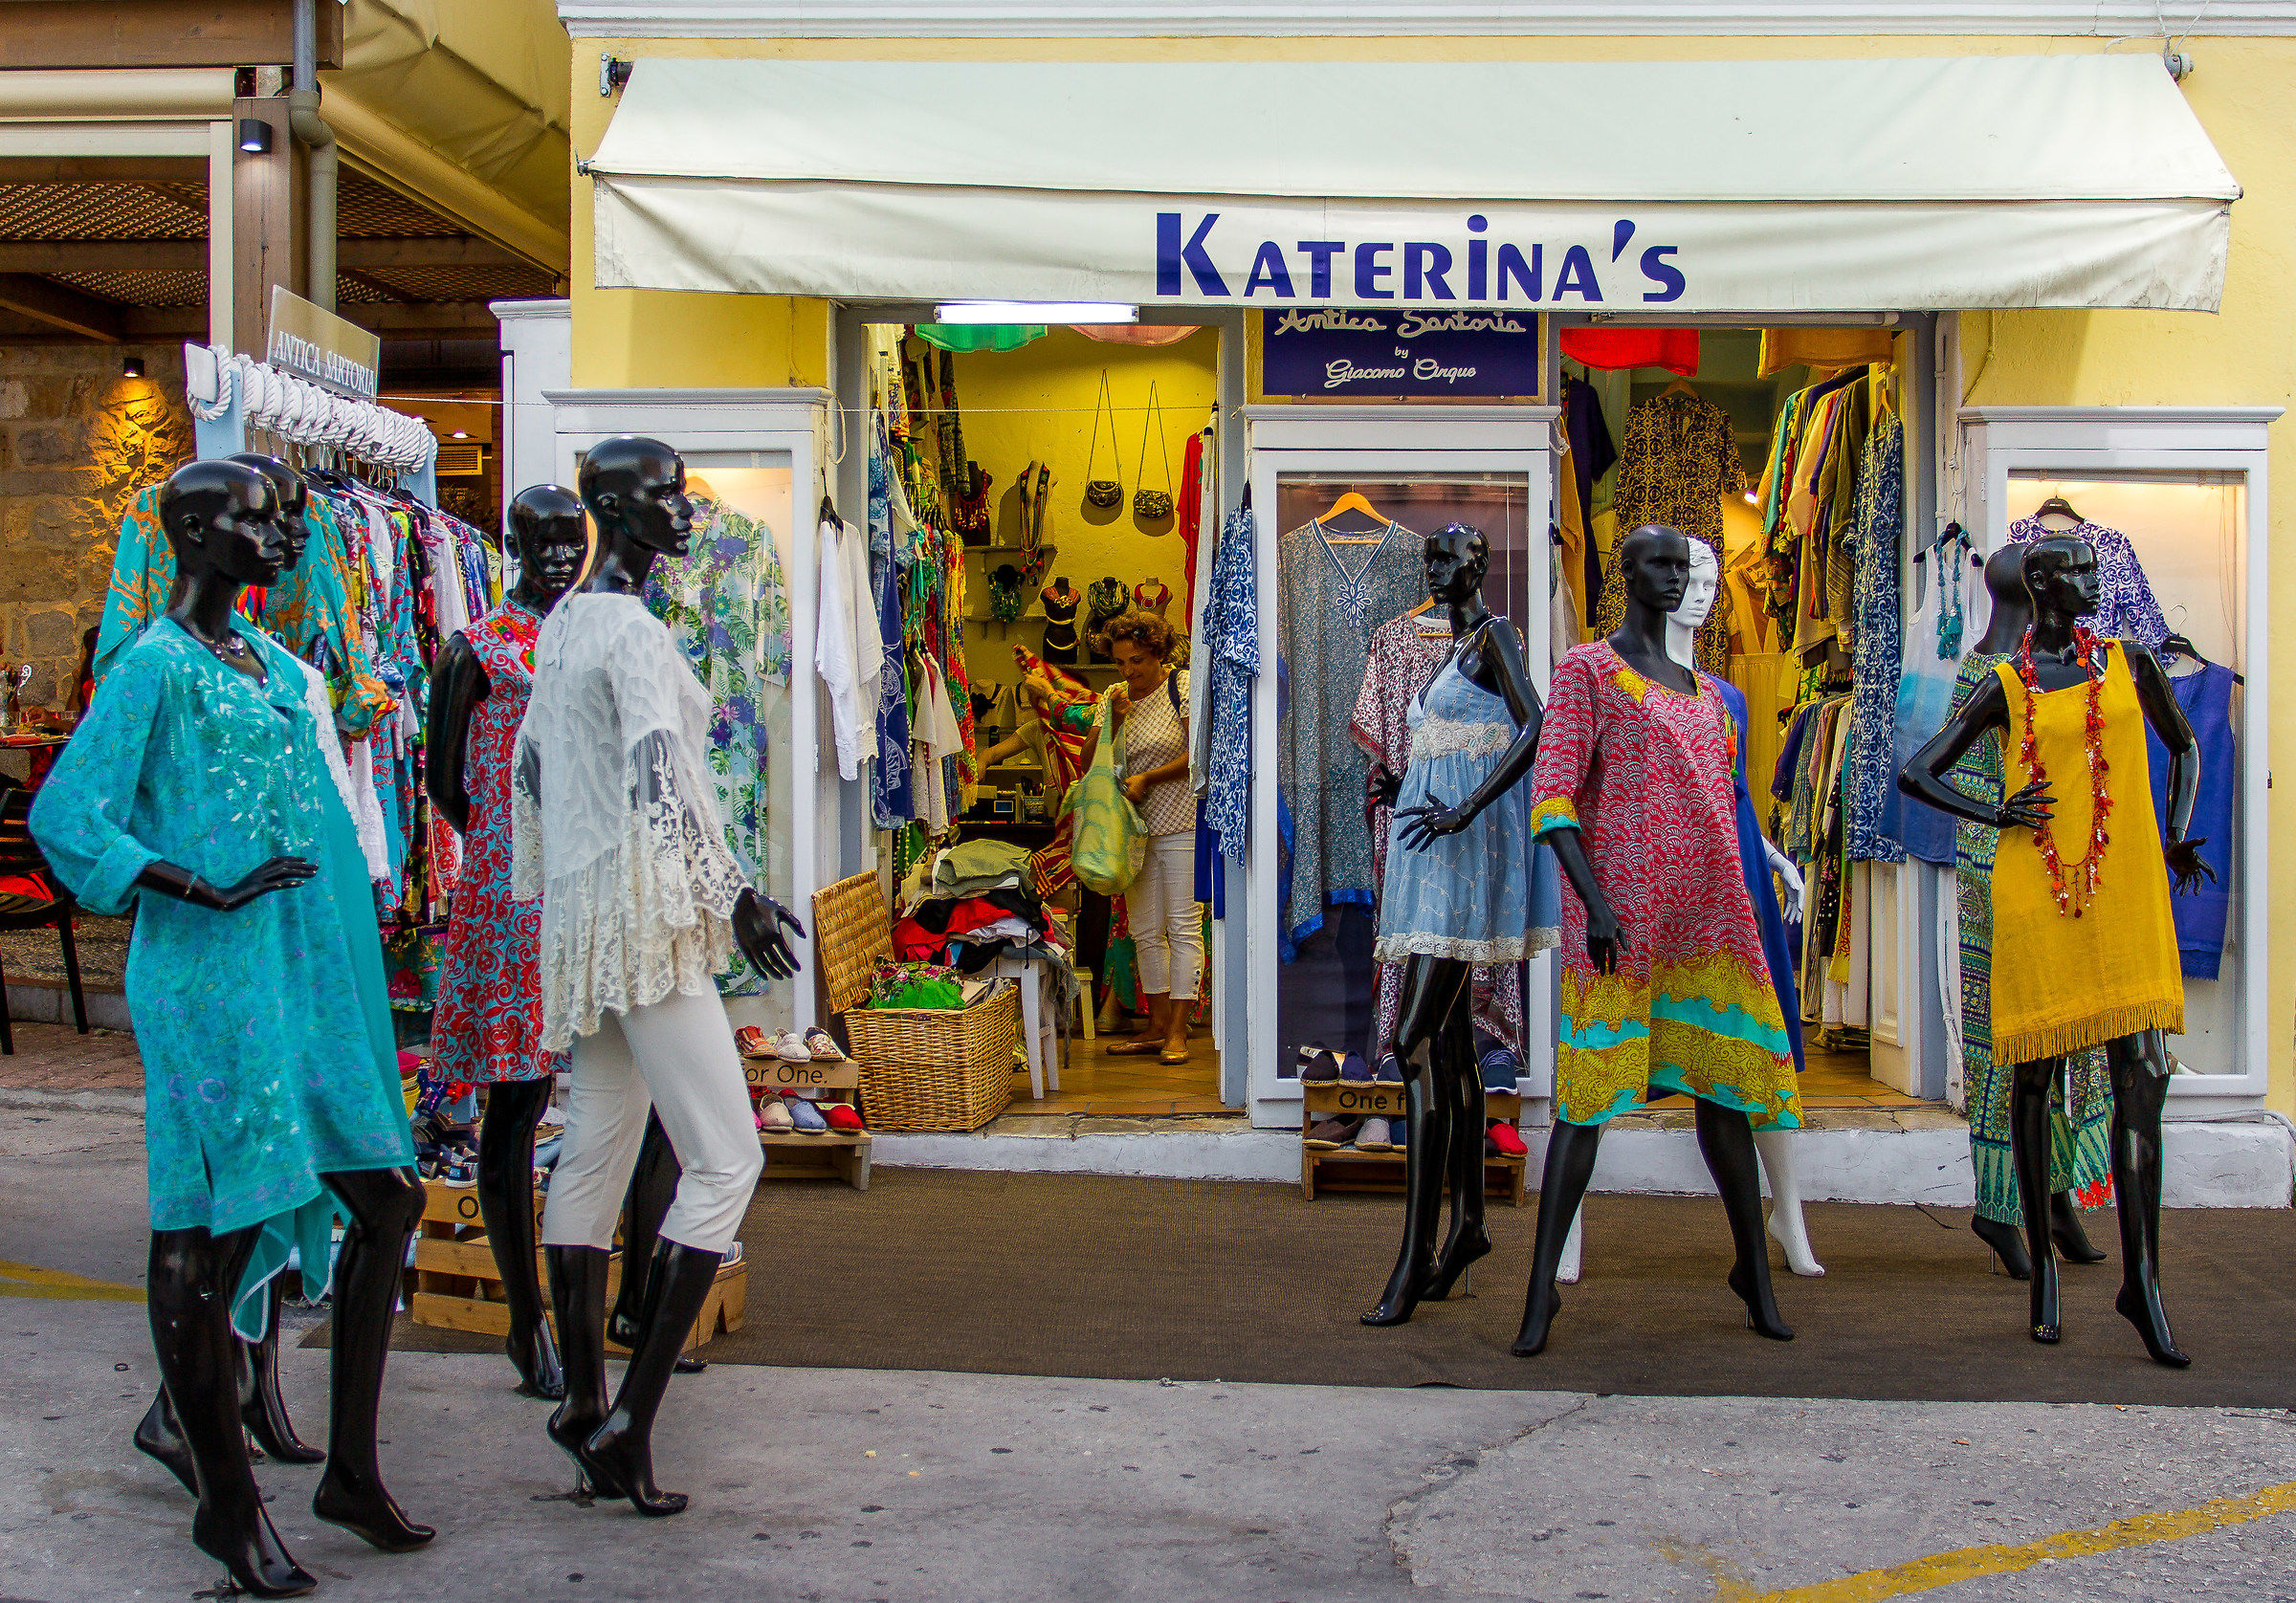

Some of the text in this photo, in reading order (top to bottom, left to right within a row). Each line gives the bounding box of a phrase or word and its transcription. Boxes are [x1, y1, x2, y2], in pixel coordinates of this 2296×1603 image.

[1274, 308, 1527, 339] Antica Sartoria
[276, 331, 375, 397] ANTICA SARTORIA
[1394, 346, 1409, 359] by
[1324, 359, 1405, 388] Giacomo
[741, 1063, 828, 1084] or One.
[1339, 1090, 1387, 1109] One
